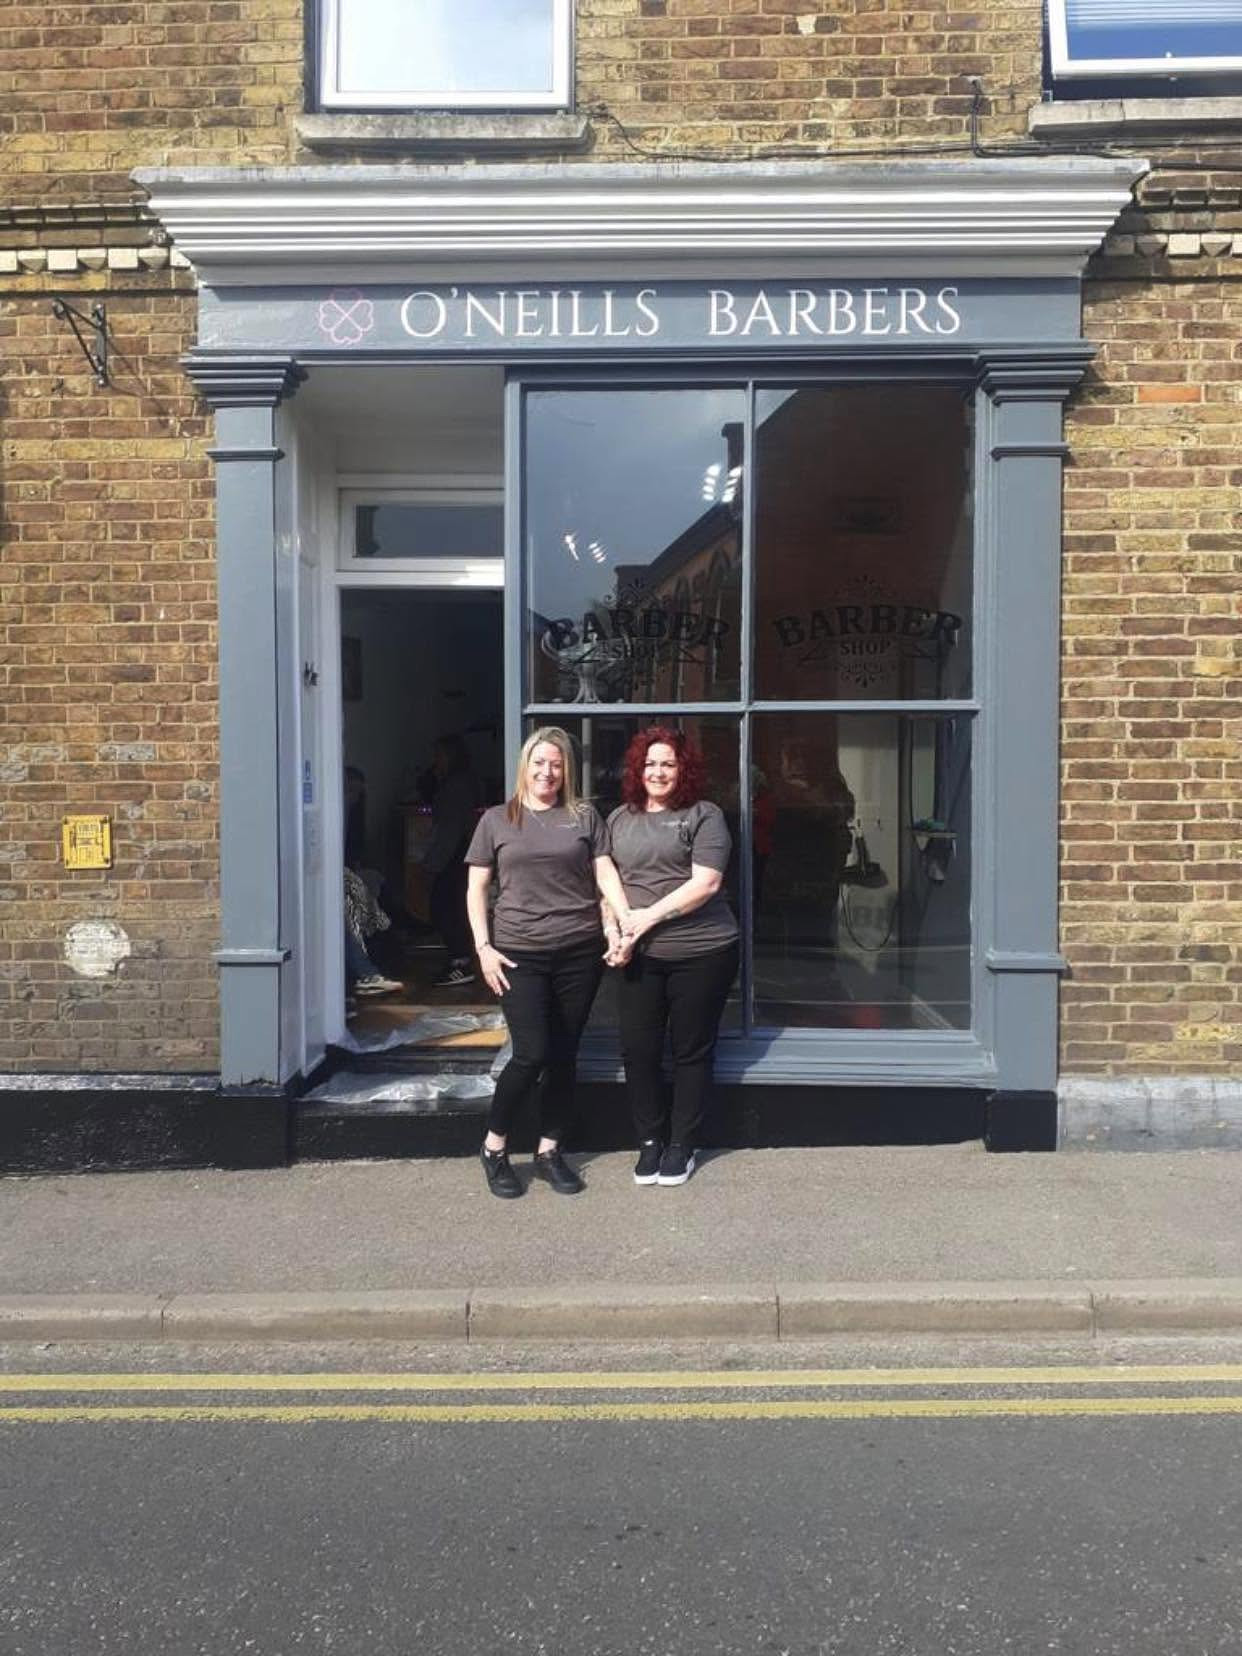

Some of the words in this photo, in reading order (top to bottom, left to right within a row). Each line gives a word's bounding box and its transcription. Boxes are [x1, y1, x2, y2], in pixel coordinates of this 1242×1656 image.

[401, 288, 660, 337] O'NEILLS
[708, 287, 961, 336] BARBERS
[545, 608, 730, 650] BARBER
[772, 604, 963, 648] BARBER
[840, 639, 891, 655] SHOP
